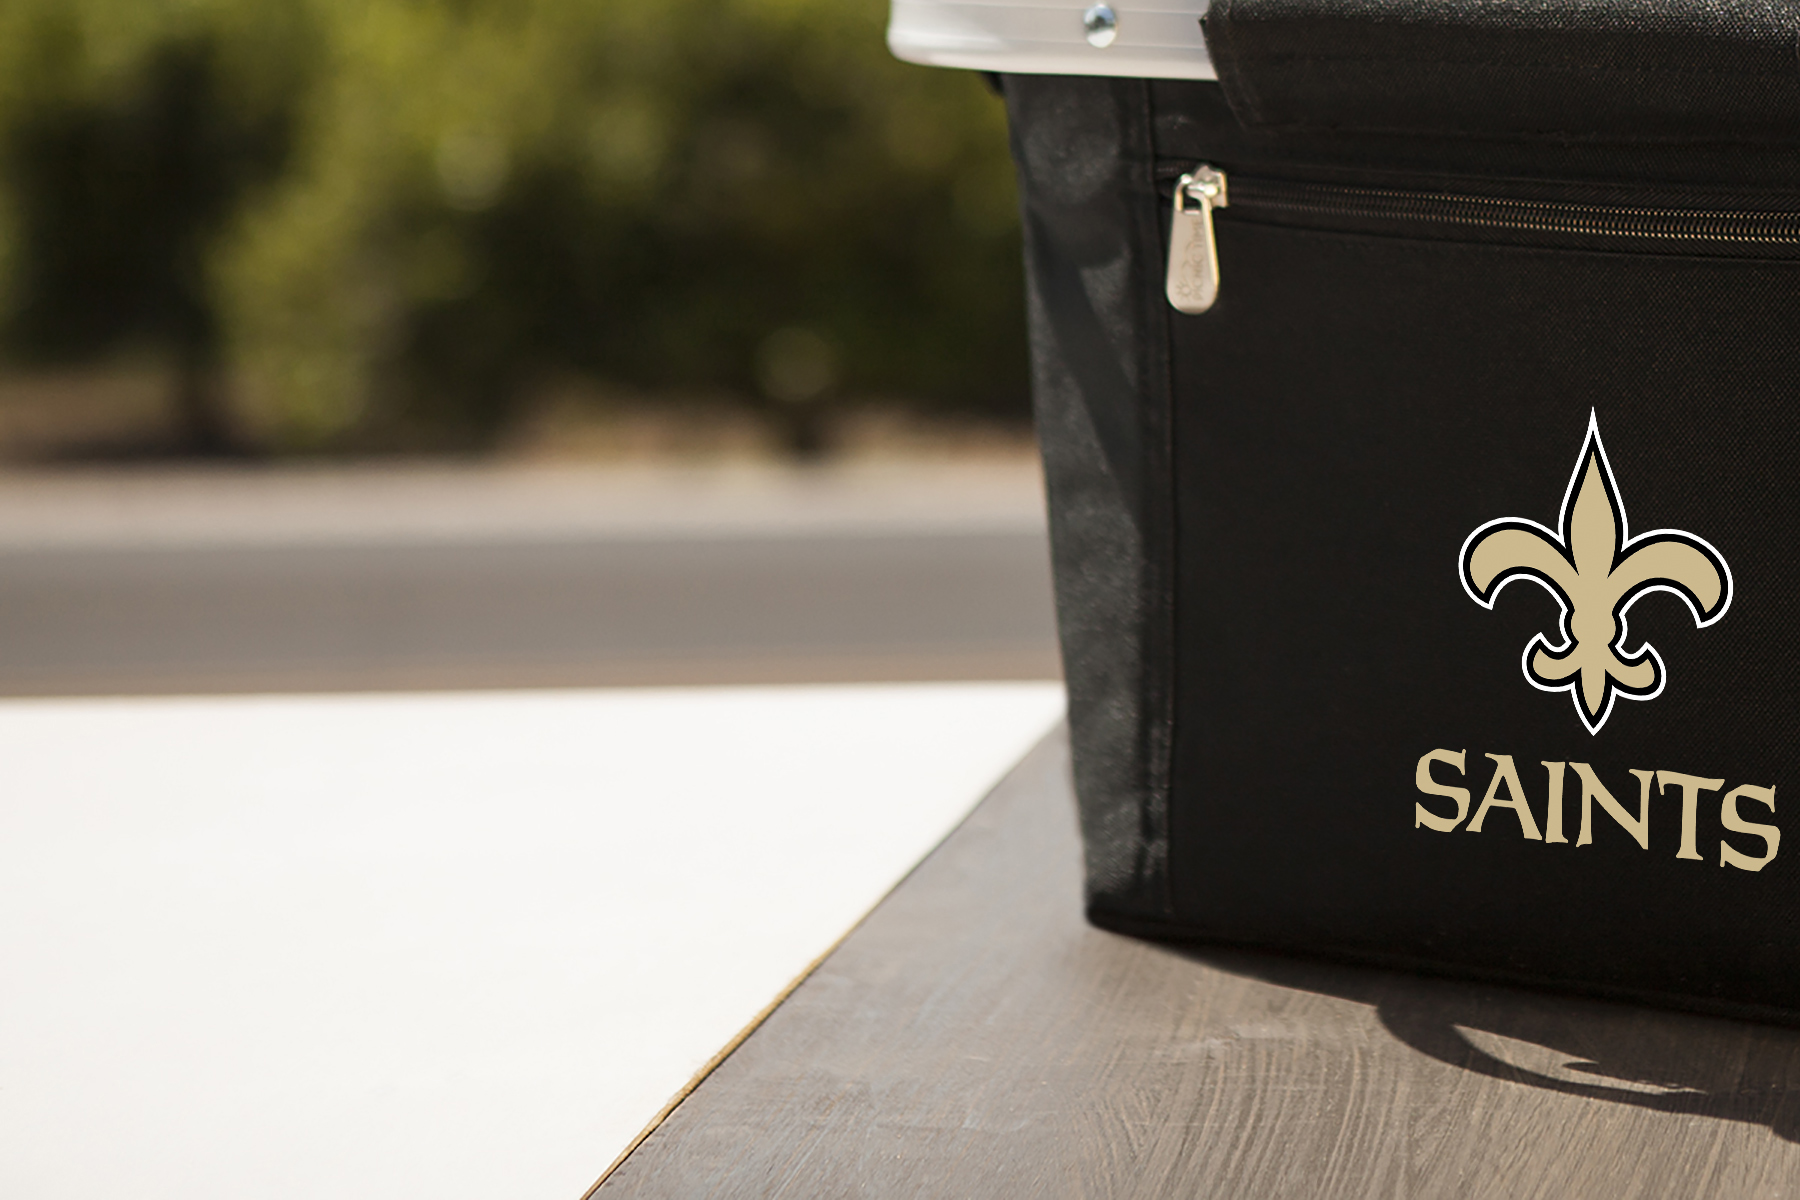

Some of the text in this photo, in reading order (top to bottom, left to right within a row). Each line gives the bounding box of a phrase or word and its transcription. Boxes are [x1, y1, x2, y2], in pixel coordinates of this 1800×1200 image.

[1192, 218, 1204, 301] PICNIC TIME
[1415, 748, 1781, 872] SAINTS
